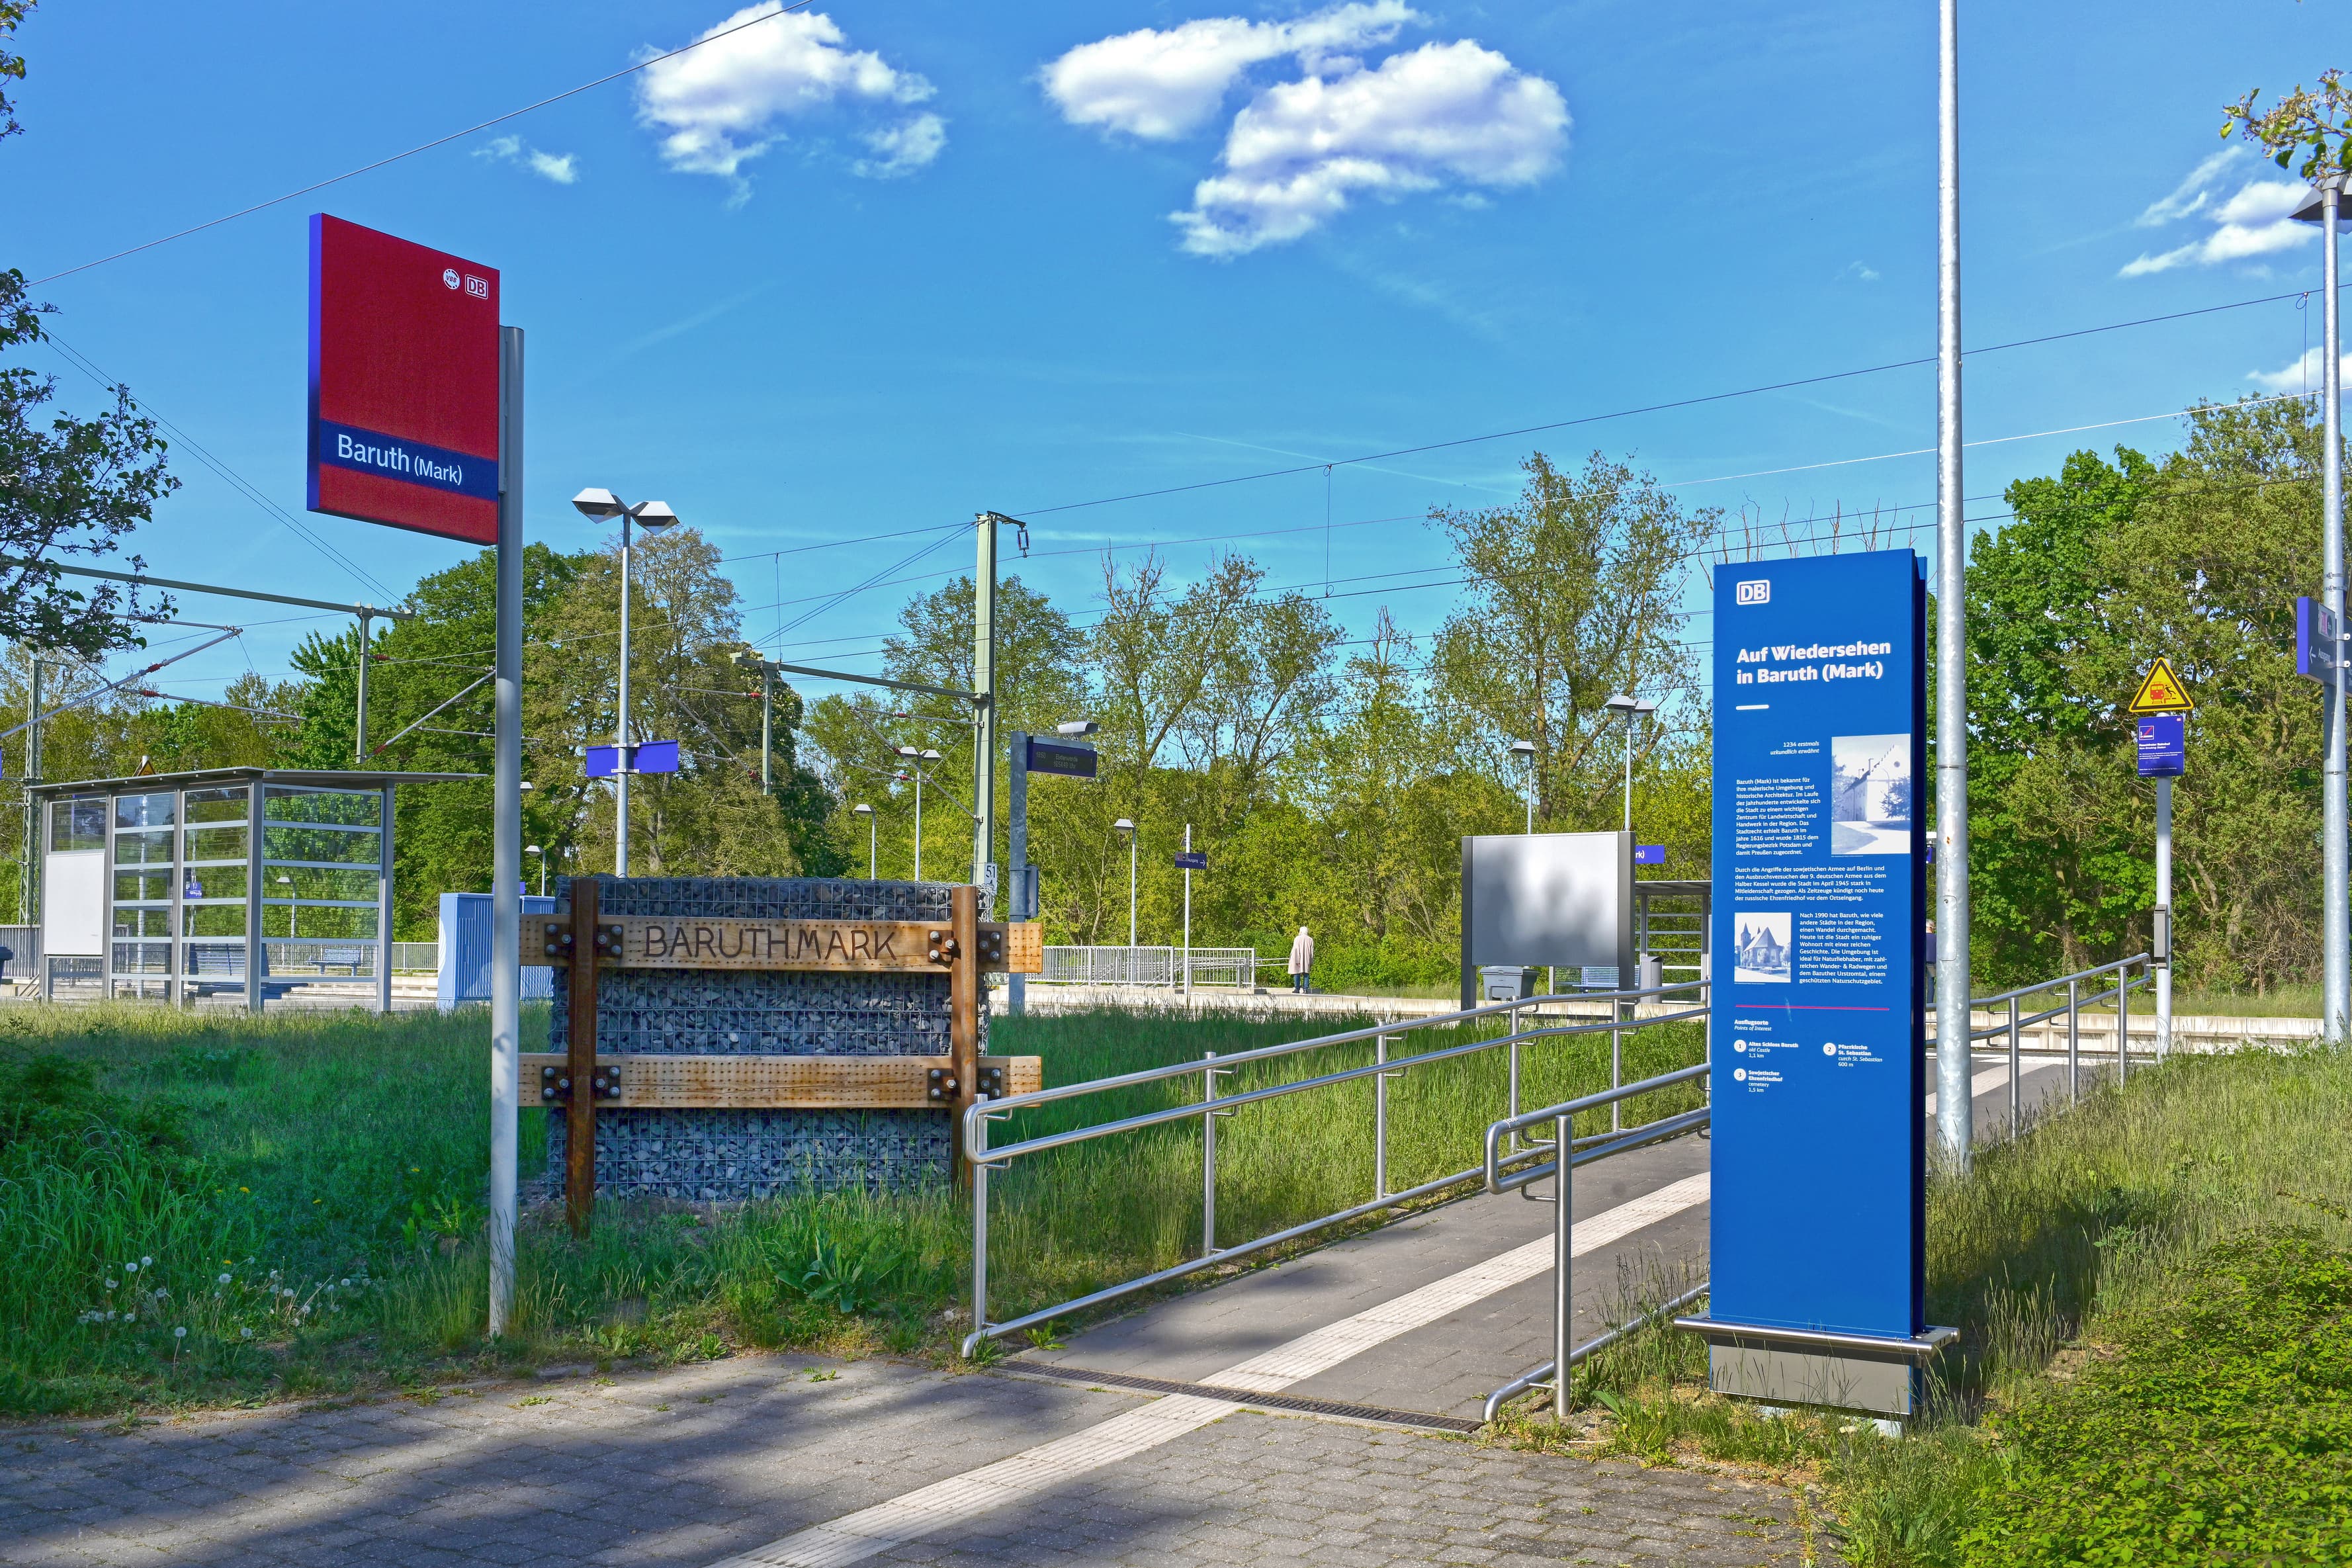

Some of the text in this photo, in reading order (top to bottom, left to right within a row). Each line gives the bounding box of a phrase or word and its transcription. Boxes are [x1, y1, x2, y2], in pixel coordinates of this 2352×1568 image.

[446, 275, 457, 283] VBB
[467, 277, 486, 296] DB
[338, 434, 462, 486] Baruth (Mark)
[1739, 582, 1767, 603] DB
[1736, 640, 1891, 663] Auf Wiedersehen
[1737, 661, 1883, 684] in Baruth (Mark)
[986, 865, 995, 878] 51
